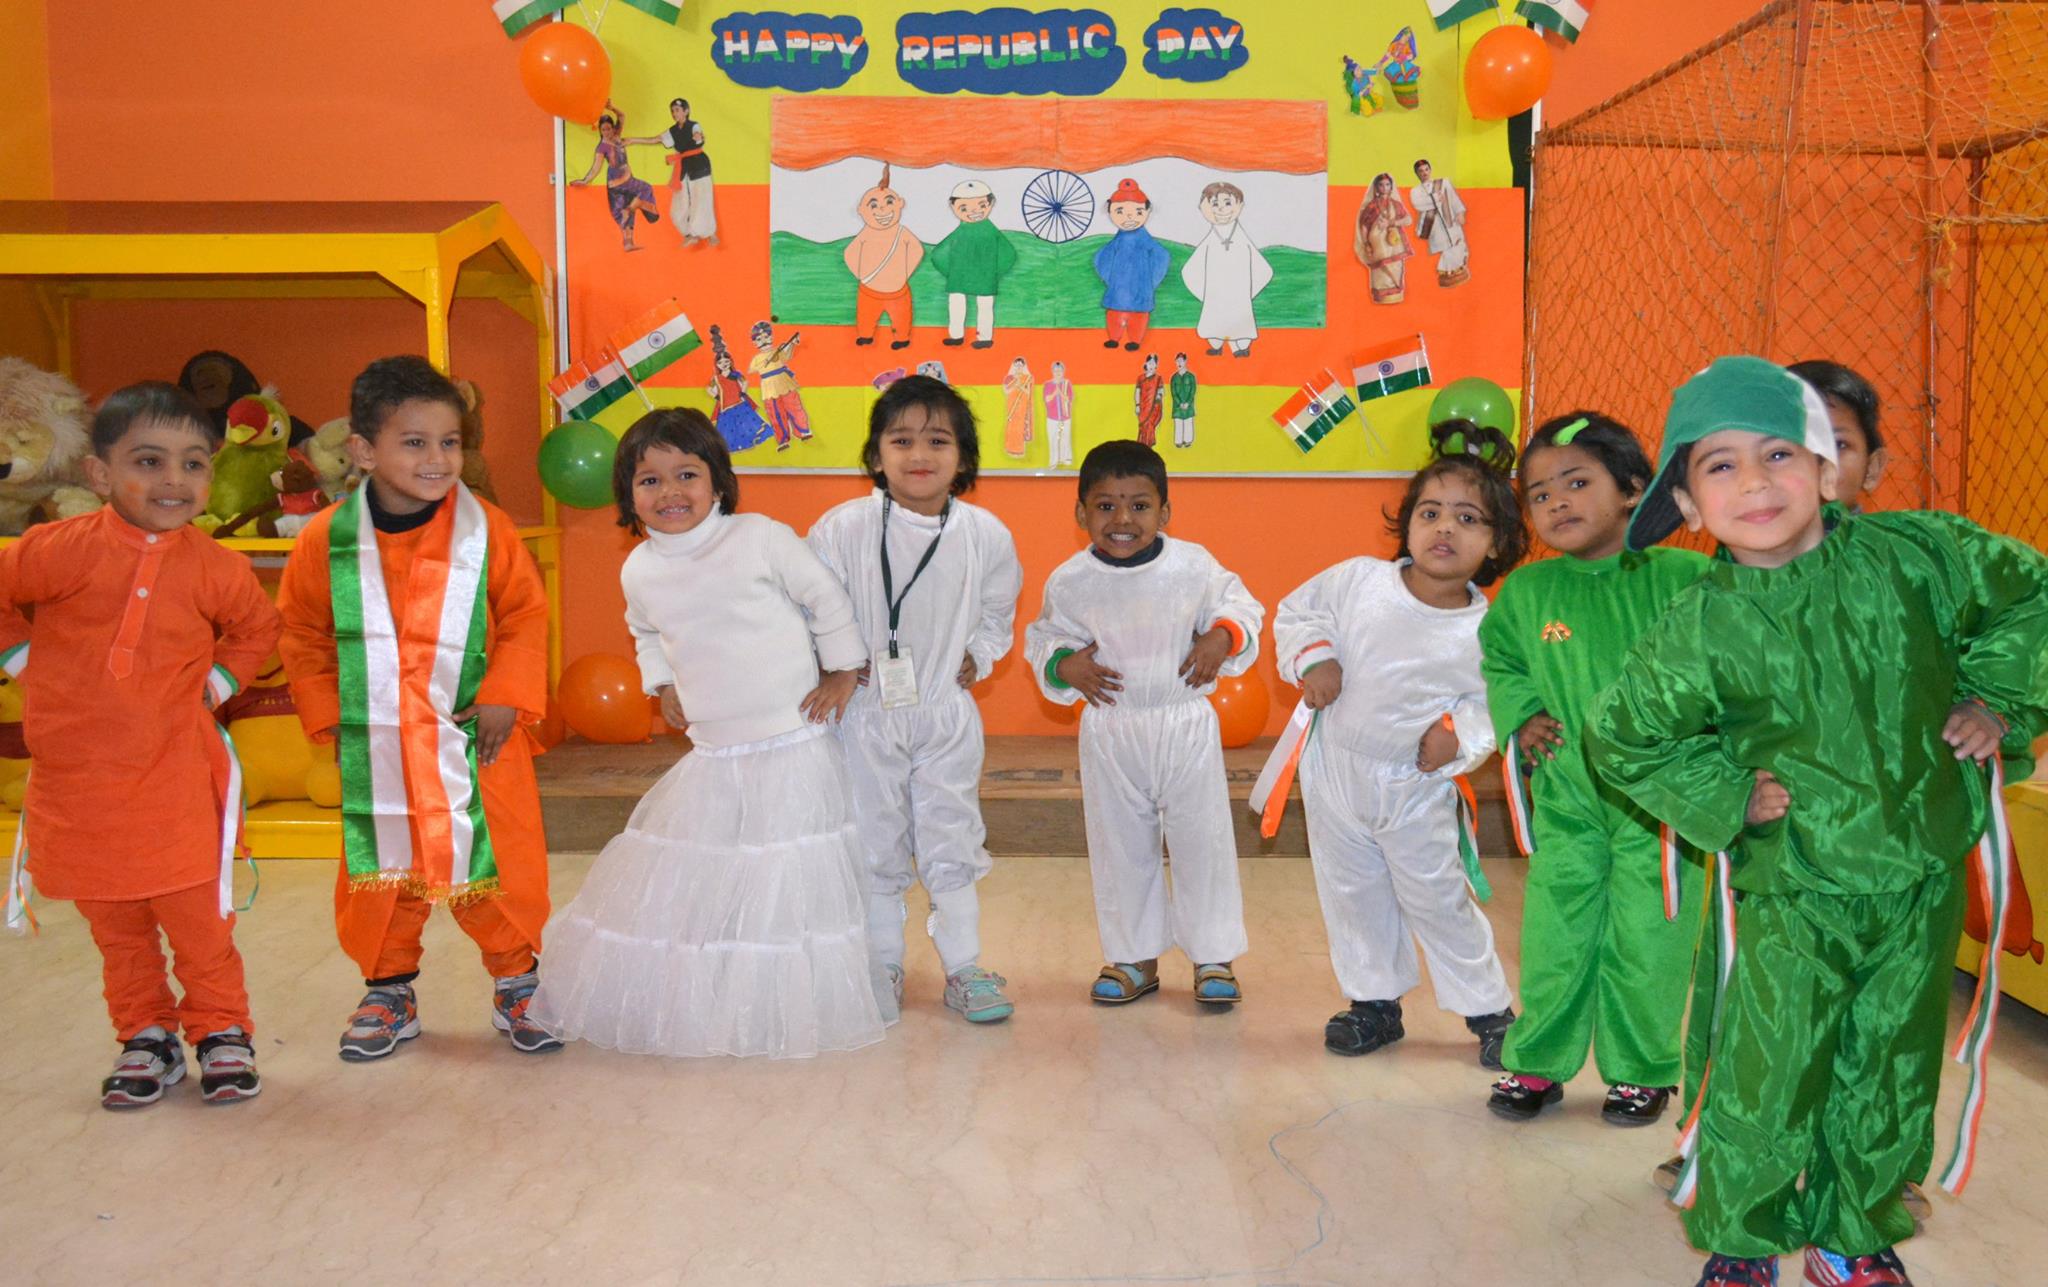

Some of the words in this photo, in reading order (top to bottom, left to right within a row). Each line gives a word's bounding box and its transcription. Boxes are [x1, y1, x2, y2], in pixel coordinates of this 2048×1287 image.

[723, 28, 865, 70] HAPPY
[902, 23, 1111, 70] REPUBLIC
[1156, 25, 1241, 64] DAY
